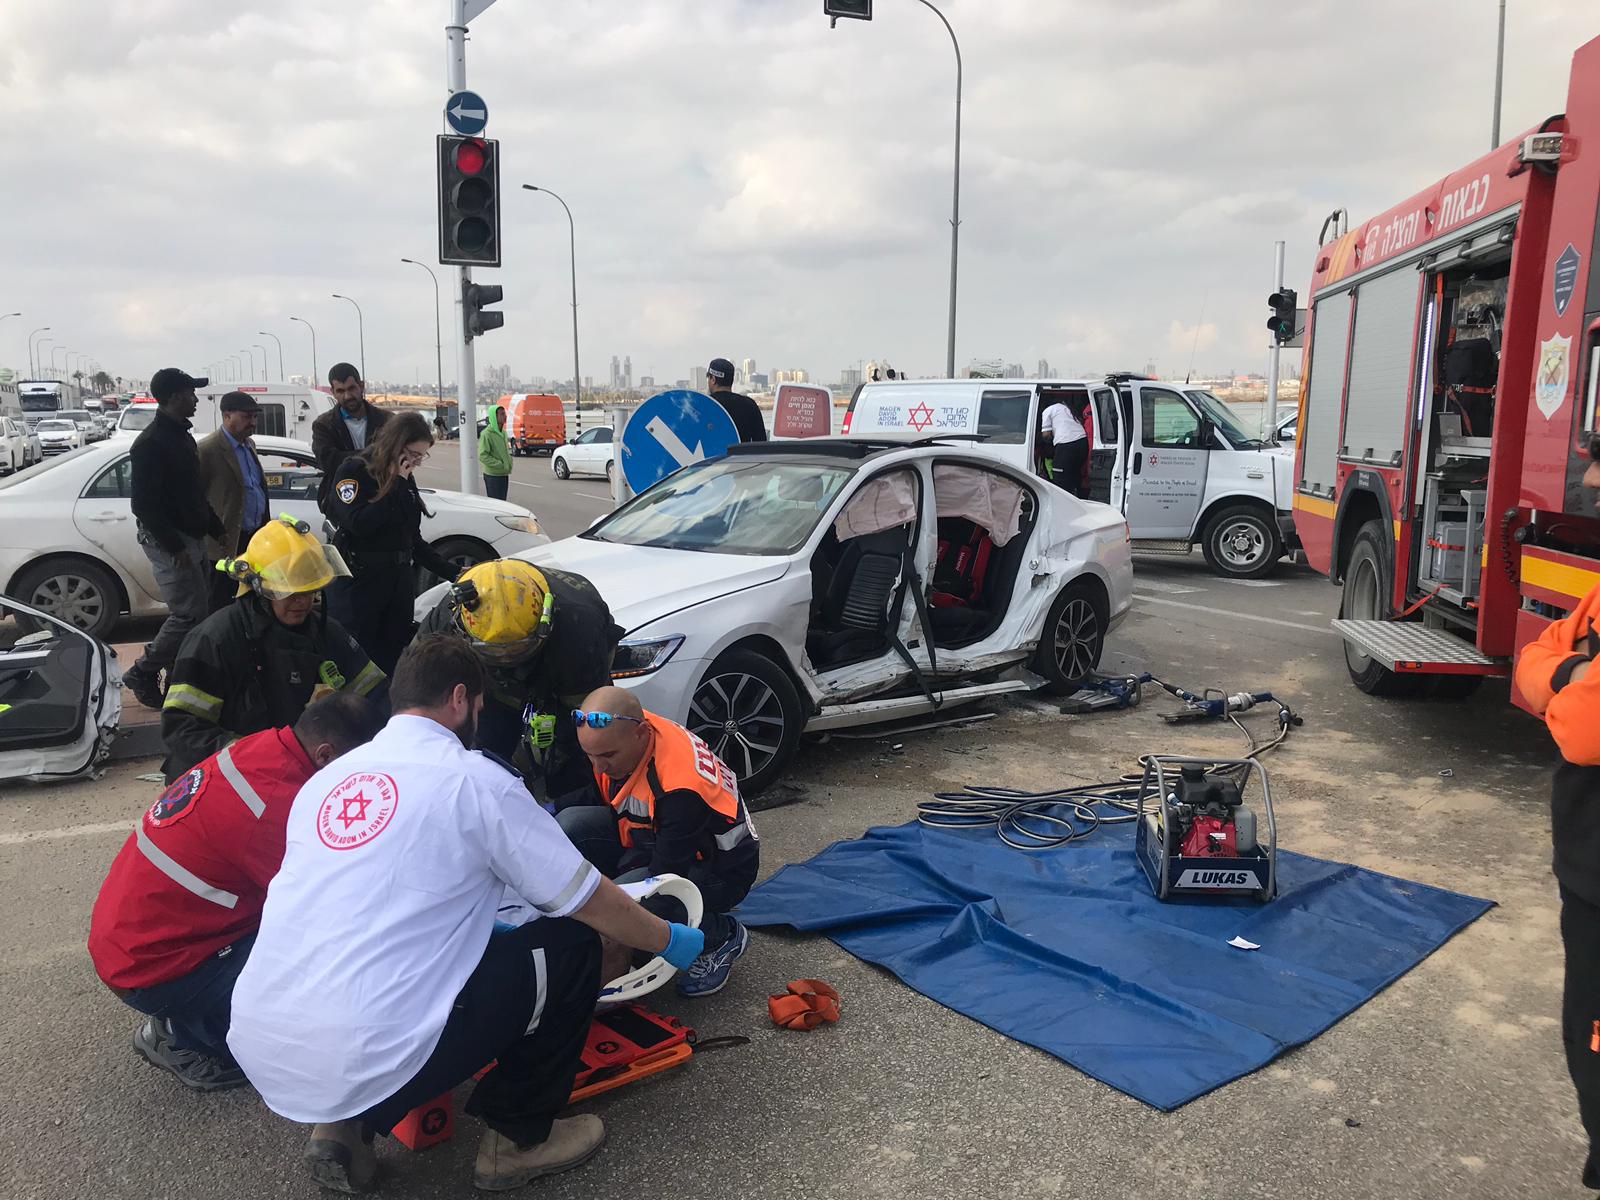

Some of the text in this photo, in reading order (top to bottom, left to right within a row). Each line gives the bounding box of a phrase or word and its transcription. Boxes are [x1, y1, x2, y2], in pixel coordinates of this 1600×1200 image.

[1438, 174, 1490, 231] כבאות
[1381, 209, 1421, 257] והצלה
[946, 413, 967, 421] אדום
[937, 420, 967, 428] בישראל
[359, 775, 376, 783] אדום
[332, 778, 357, 799] בישראל
[381, 788, 391, 800] מגן
[322, 805, 389, 844] MAGEN DAVID ADOM IN ISRAEL
[1192, 872, 1248, 884] LUKAS
